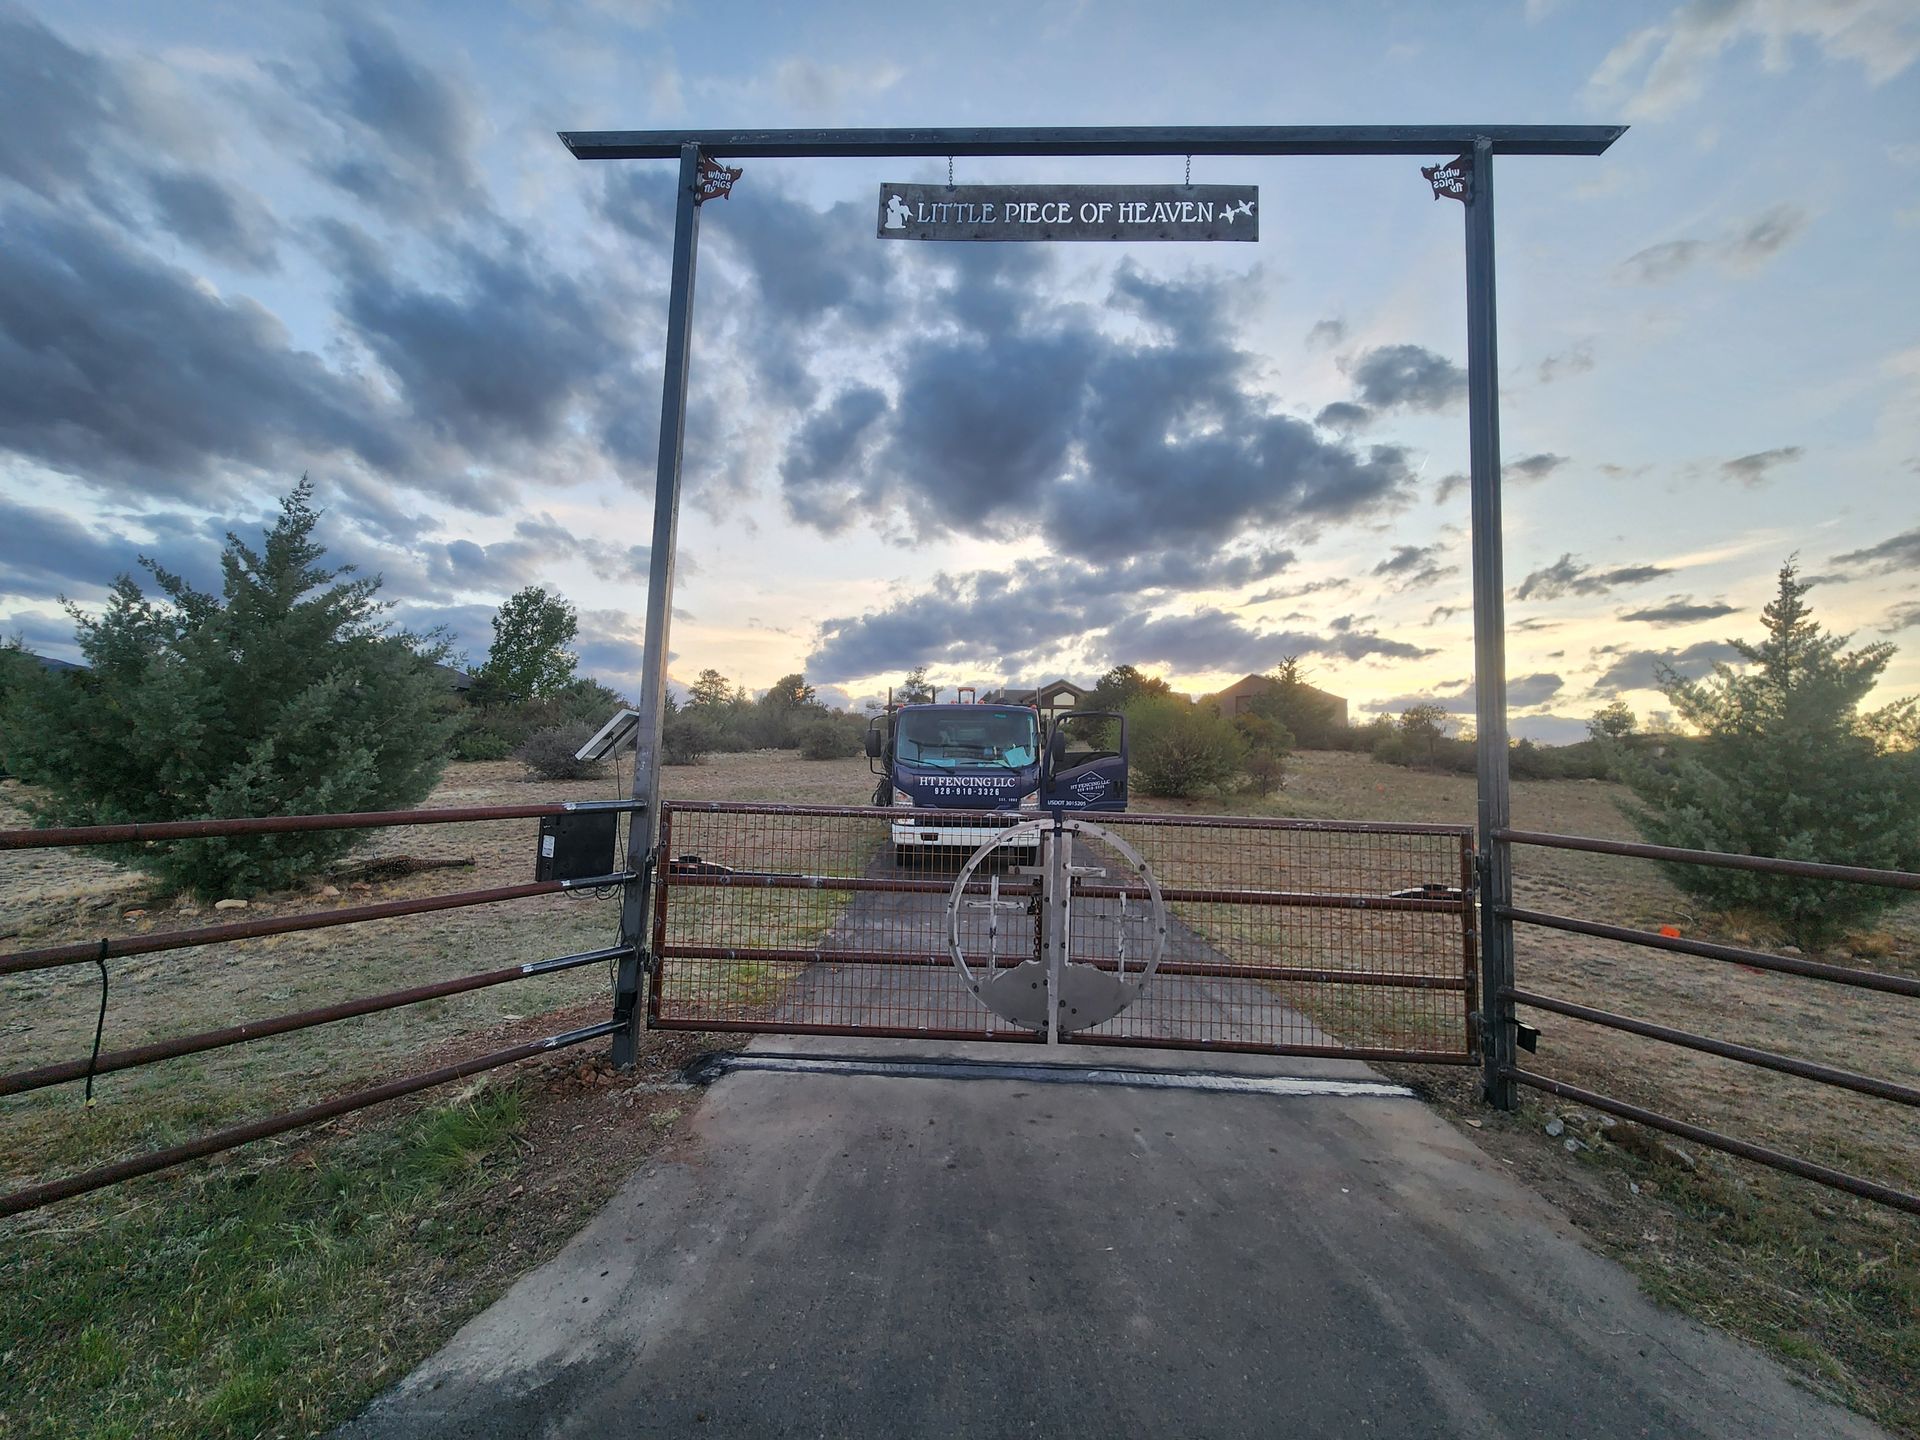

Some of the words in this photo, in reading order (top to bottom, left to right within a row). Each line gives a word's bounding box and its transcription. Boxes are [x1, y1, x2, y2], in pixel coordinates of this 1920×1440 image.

[708, 170, 731, 180] when
[917, 202, 997, 223] LITTLE
[1004, 202, 1074, 223] PIECE
[1080, 202, 1113, 223] OF
[1118, 201, 1215, 223] HEAVEN
[919, 776, 937, 786] HT
[938, 777, 991, 787] FENCING
[993, 777, 1016, 788] LLC
[934, 787, 1000, 796] 928-910-3326
